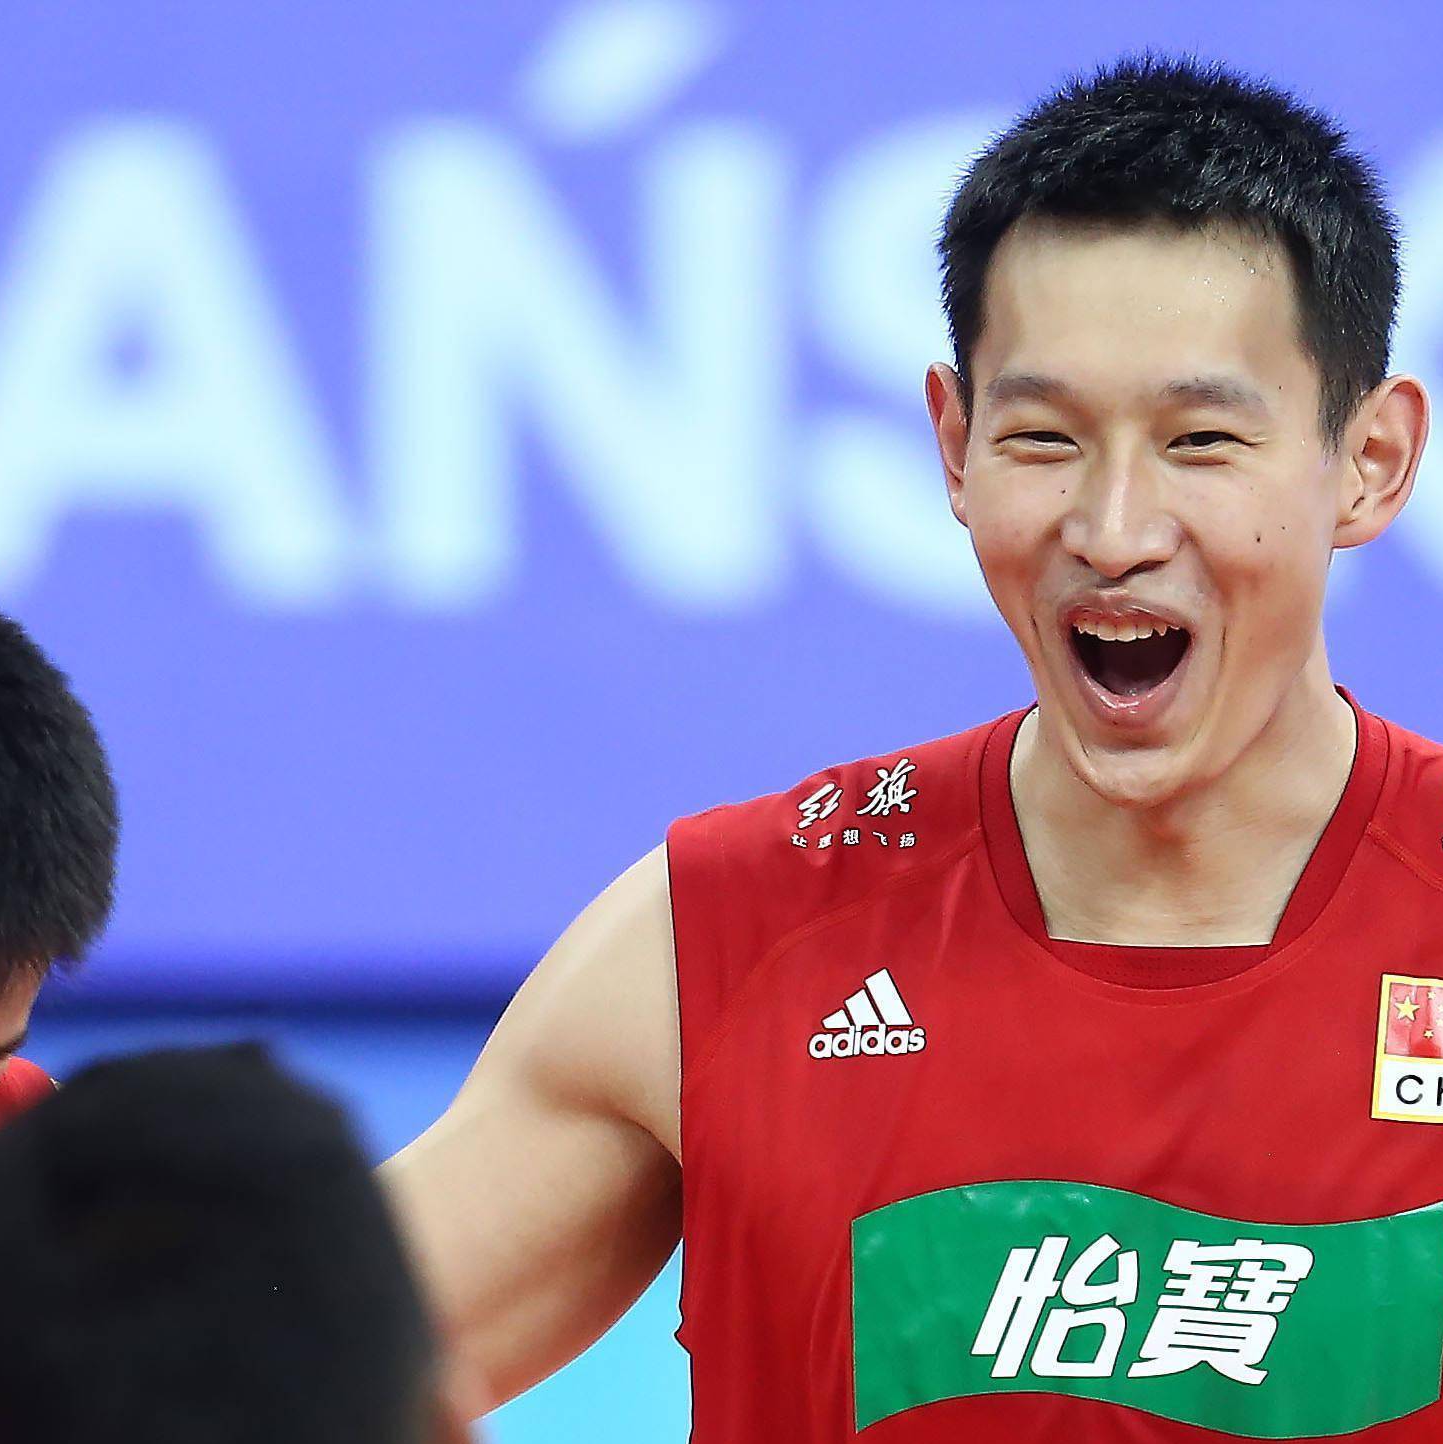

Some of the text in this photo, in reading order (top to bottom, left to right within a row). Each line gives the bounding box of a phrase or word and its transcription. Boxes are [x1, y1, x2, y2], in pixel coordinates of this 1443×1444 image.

[797, 758, 917, 829] 红旗
[809, 1023, 926, 1059] adidas
[970, 1233, 1314, 1385] 怡寶
